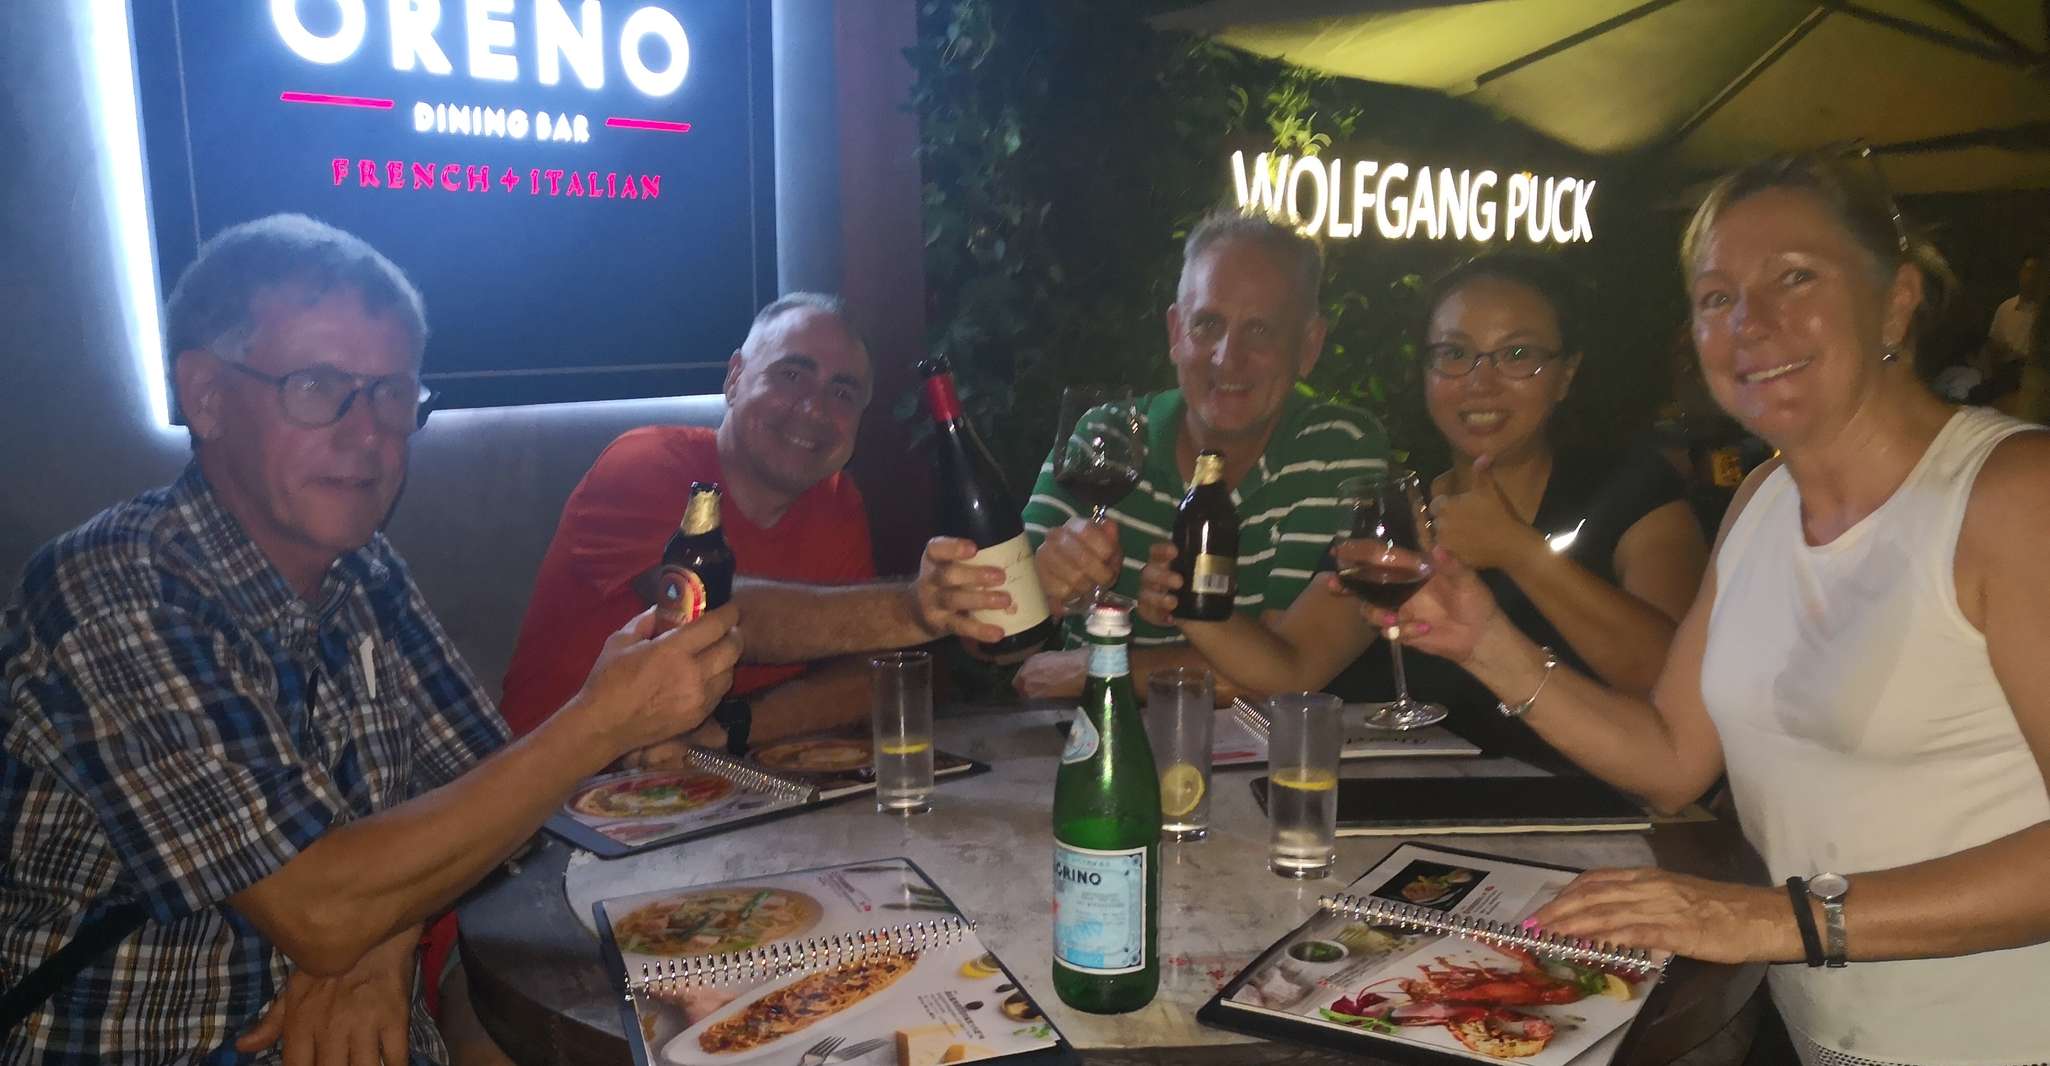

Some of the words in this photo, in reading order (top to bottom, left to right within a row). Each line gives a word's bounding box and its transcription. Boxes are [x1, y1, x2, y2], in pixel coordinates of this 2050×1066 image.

[270, 0, 690, 97] ORENO
[413, 101, 530, 140] DINING
[535, 110, 591, 144] BAR
[331, 157, 491, 194] FRENCH
[529, 167, 662, 201] ITALIAN
[1231, 149, 1498, 243] WOLFGANG
[1505, 172, 1597, 244] PUCK
